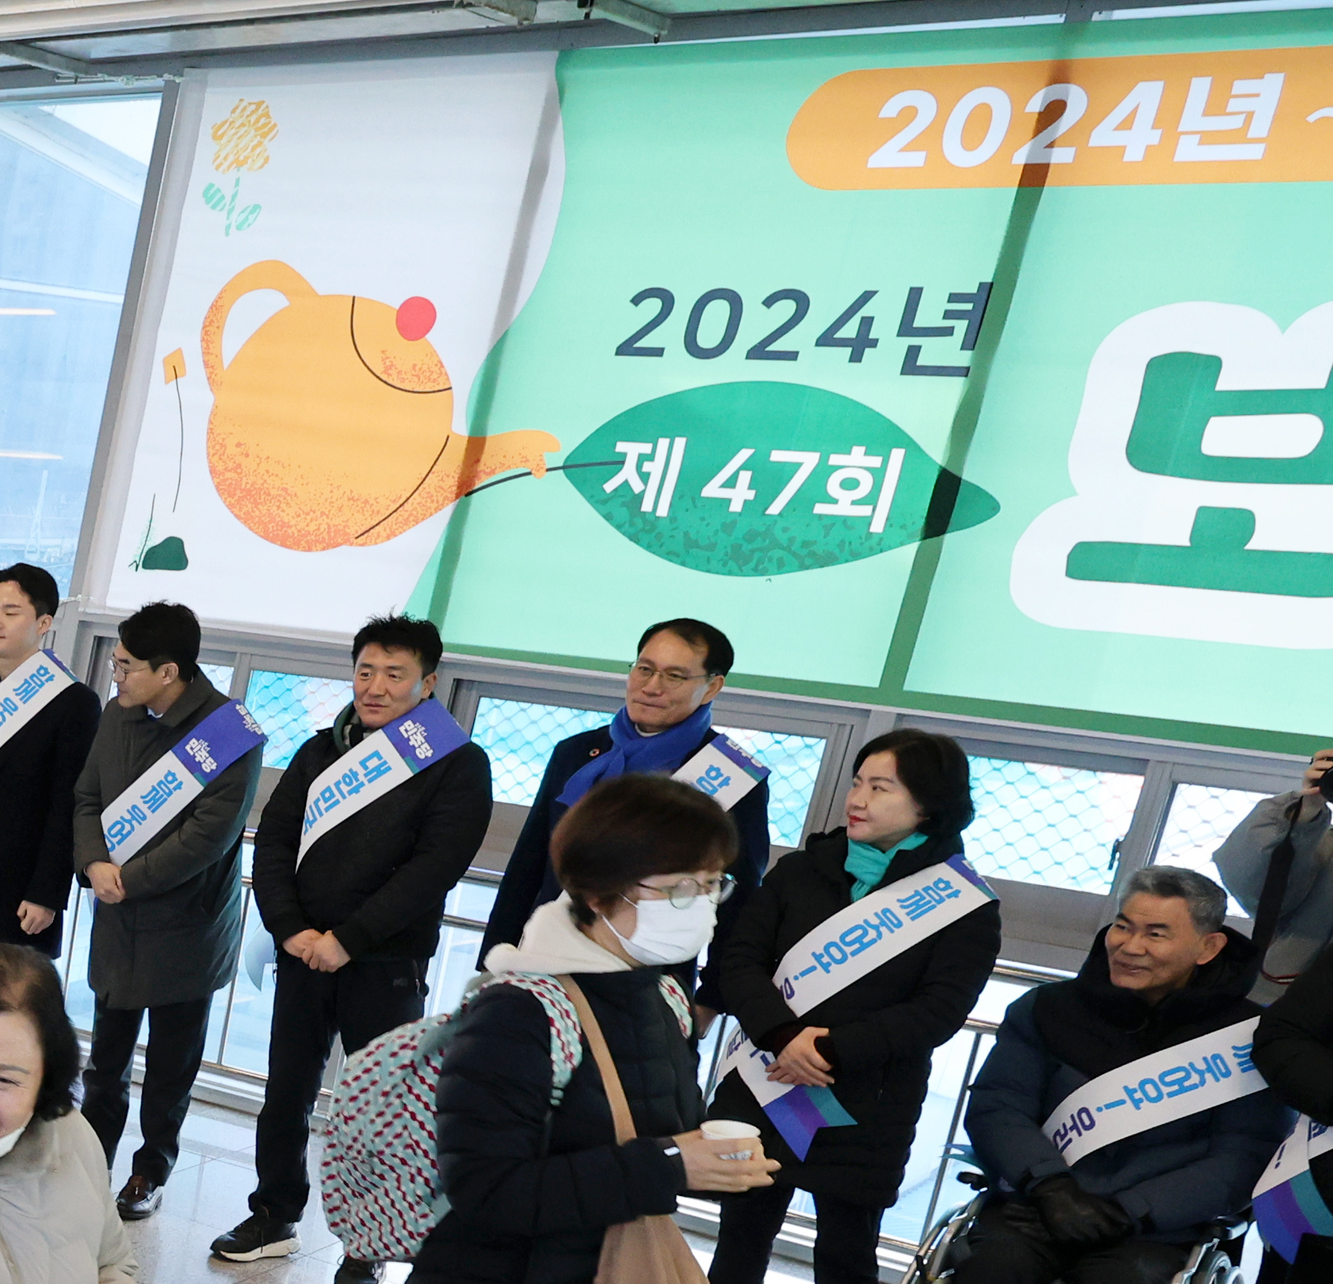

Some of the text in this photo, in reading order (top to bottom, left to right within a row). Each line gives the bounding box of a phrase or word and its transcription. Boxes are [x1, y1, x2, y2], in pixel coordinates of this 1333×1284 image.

[866, 72, 1286, 169] 2024년
[614, 279, 994, 378] 2024년
[602, 436, 907, 535] 제 47회
[13, 664, 56, 705] 함께
[185, 737, 218, 773] 민주당
[398, 719, 435, 760] 민주당
[140, 770, 184, 814] 함께
[690, 764, 732, 796] 함
[896, 877, 962, 921] 함께
